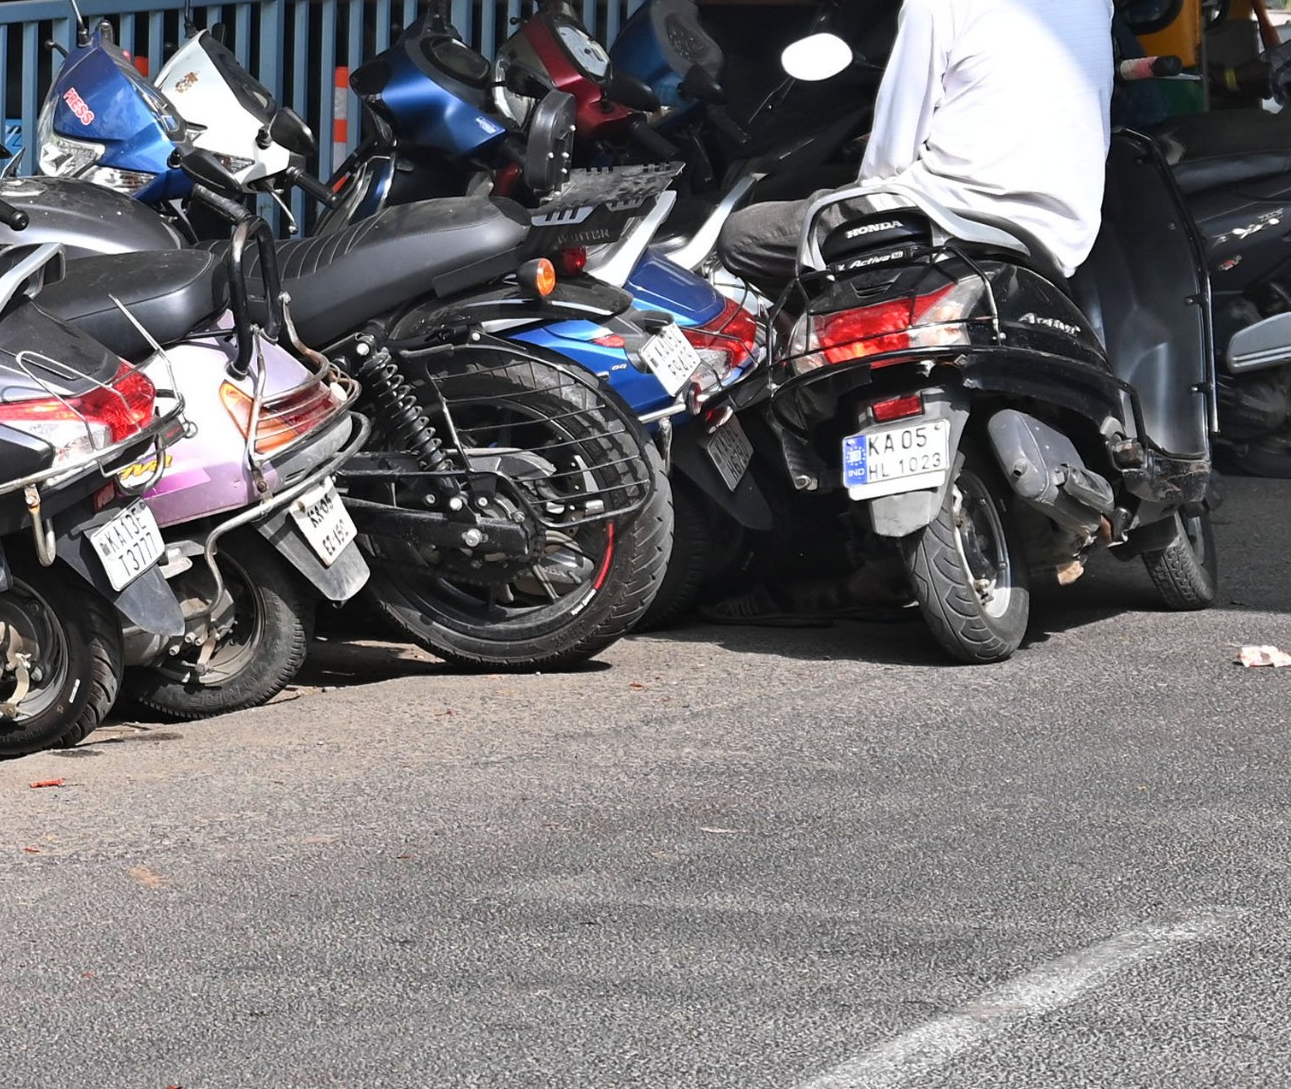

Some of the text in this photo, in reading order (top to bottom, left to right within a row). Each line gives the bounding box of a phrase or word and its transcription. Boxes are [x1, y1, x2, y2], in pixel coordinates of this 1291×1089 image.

[63, 87, 95, 126] PRESS
[845, 220, 904, 239] HONDA
[849, 255, 891, 269] Activa
[868, 426, 927, 457] KA 05
[869, 452, 941, 480] HL 1023
